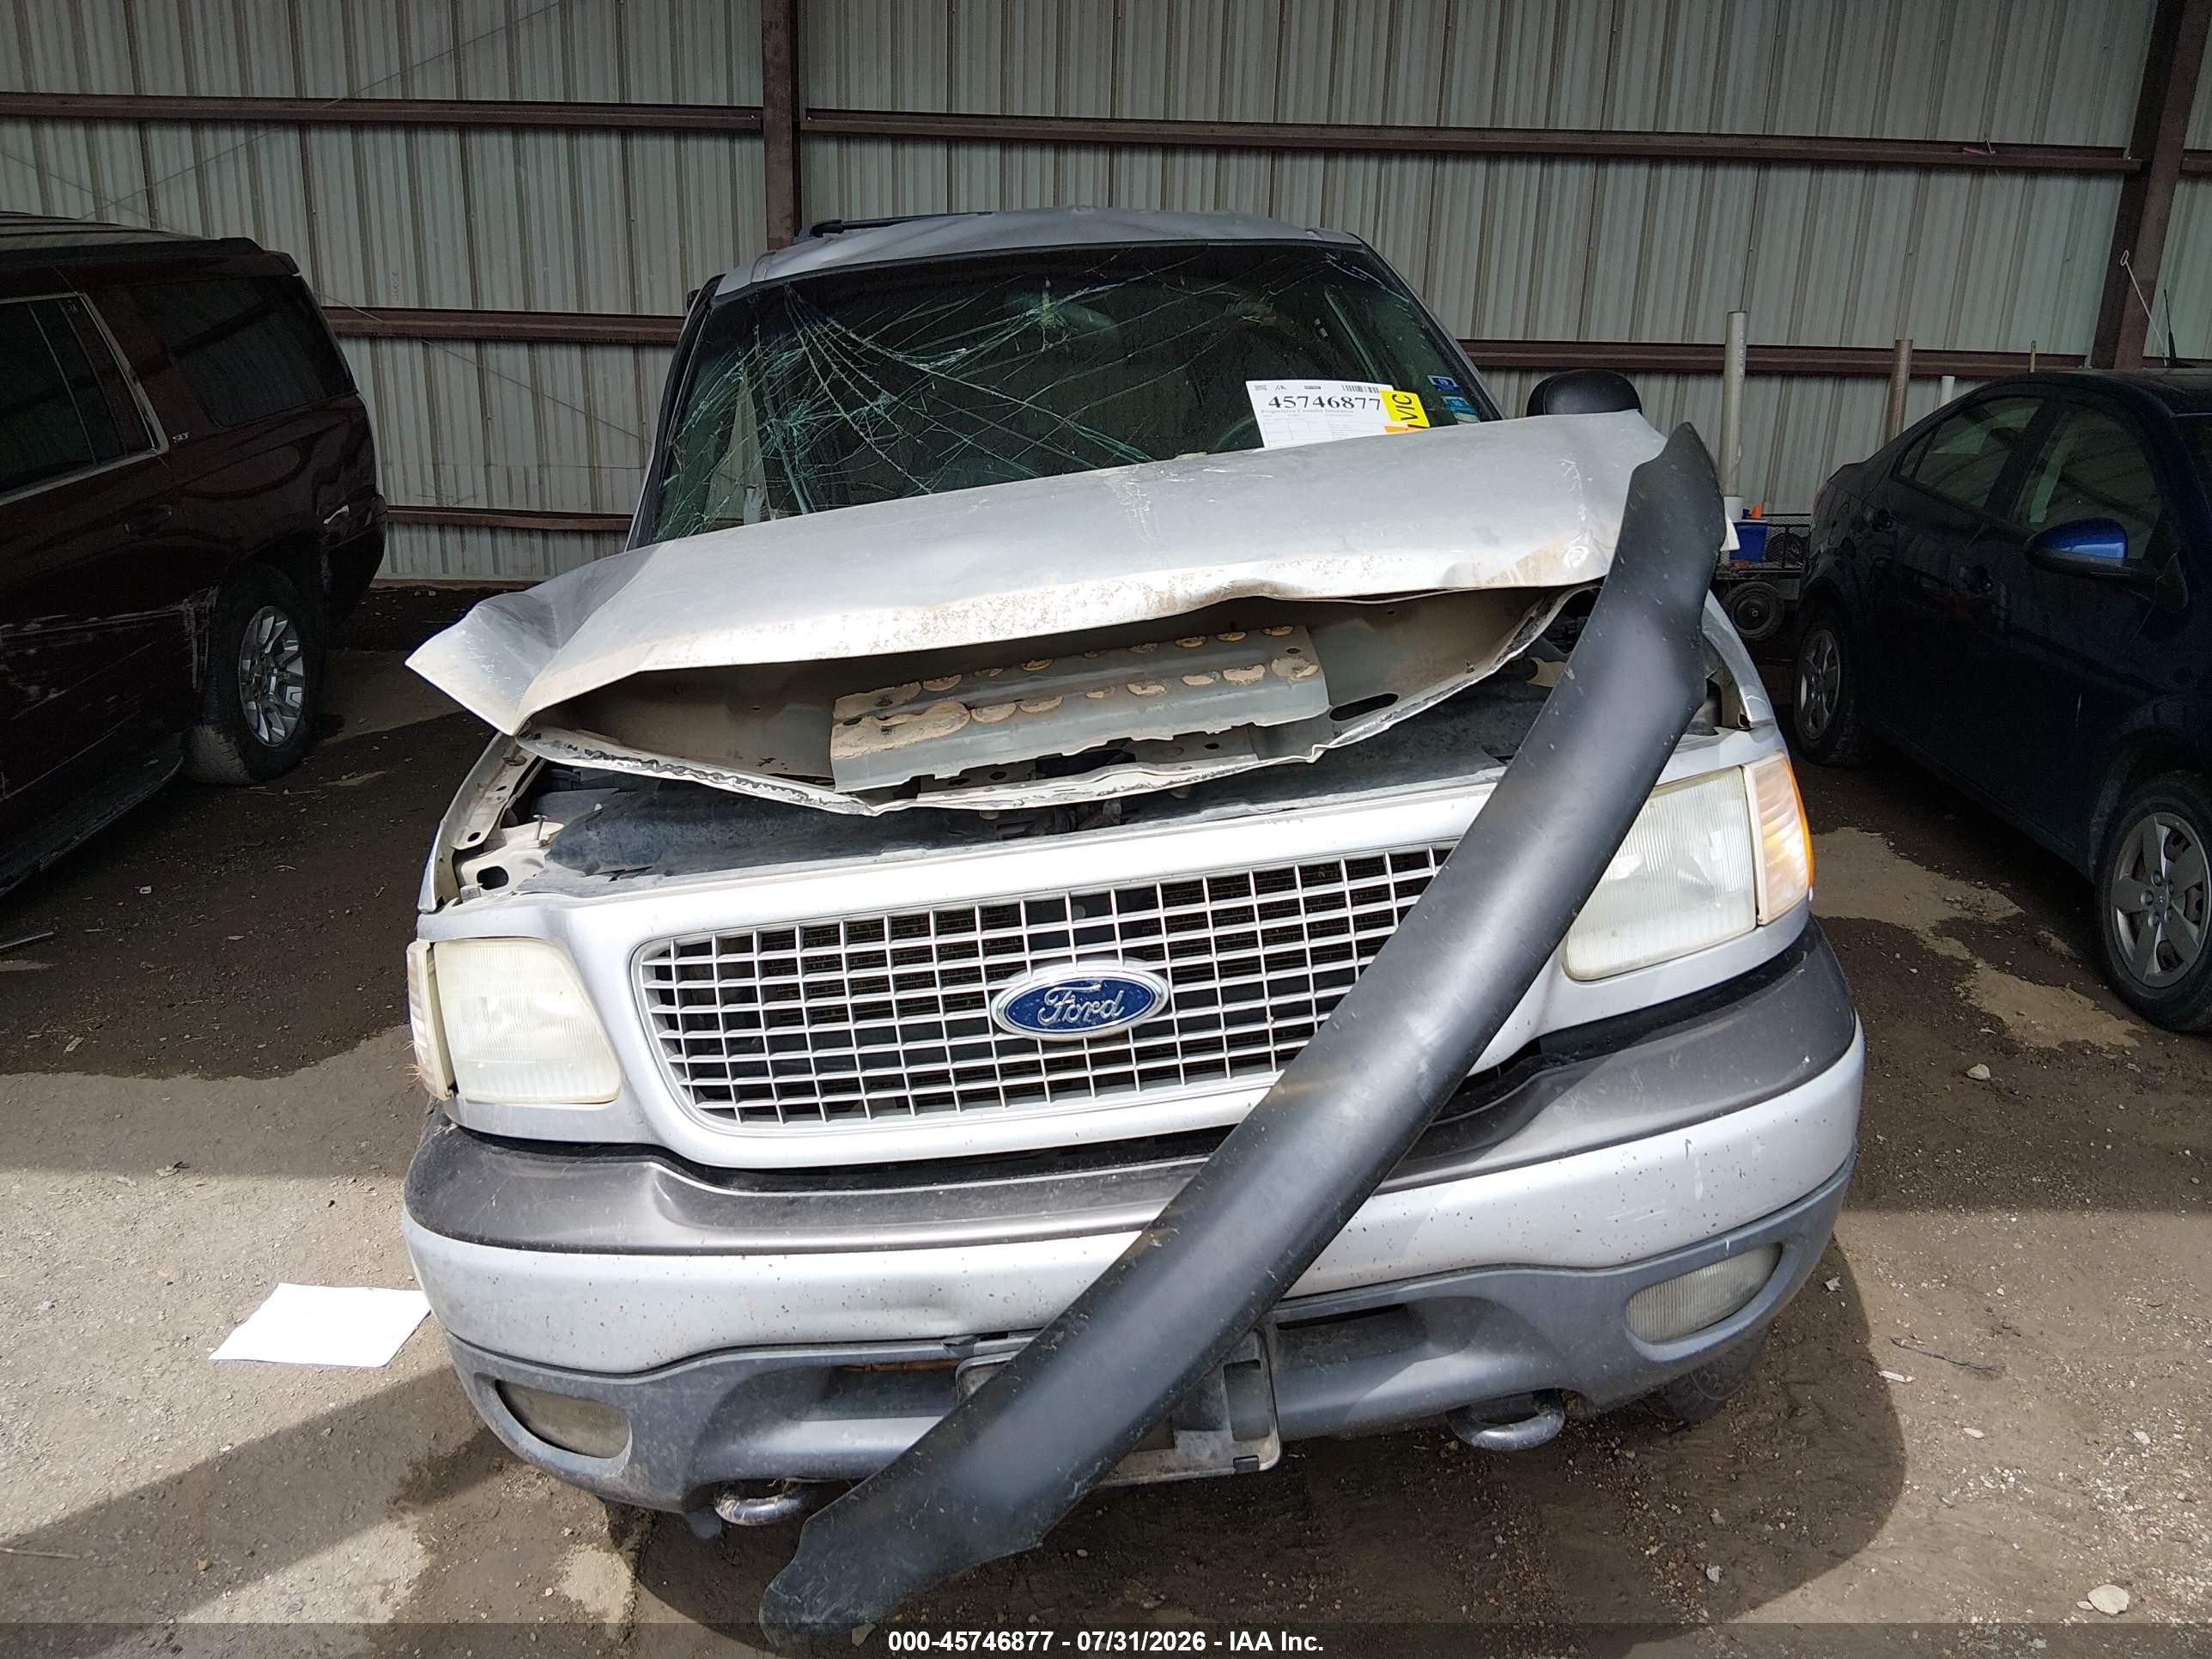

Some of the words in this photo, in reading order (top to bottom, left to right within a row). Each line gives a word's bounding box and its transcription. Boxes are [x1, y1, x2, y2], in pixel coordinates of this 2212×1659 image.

[1268, 395, 1381, 410] 45746877
[1391, 393, 1419, 421] VIC
[1037, 983, 1125, 1026] Ford
